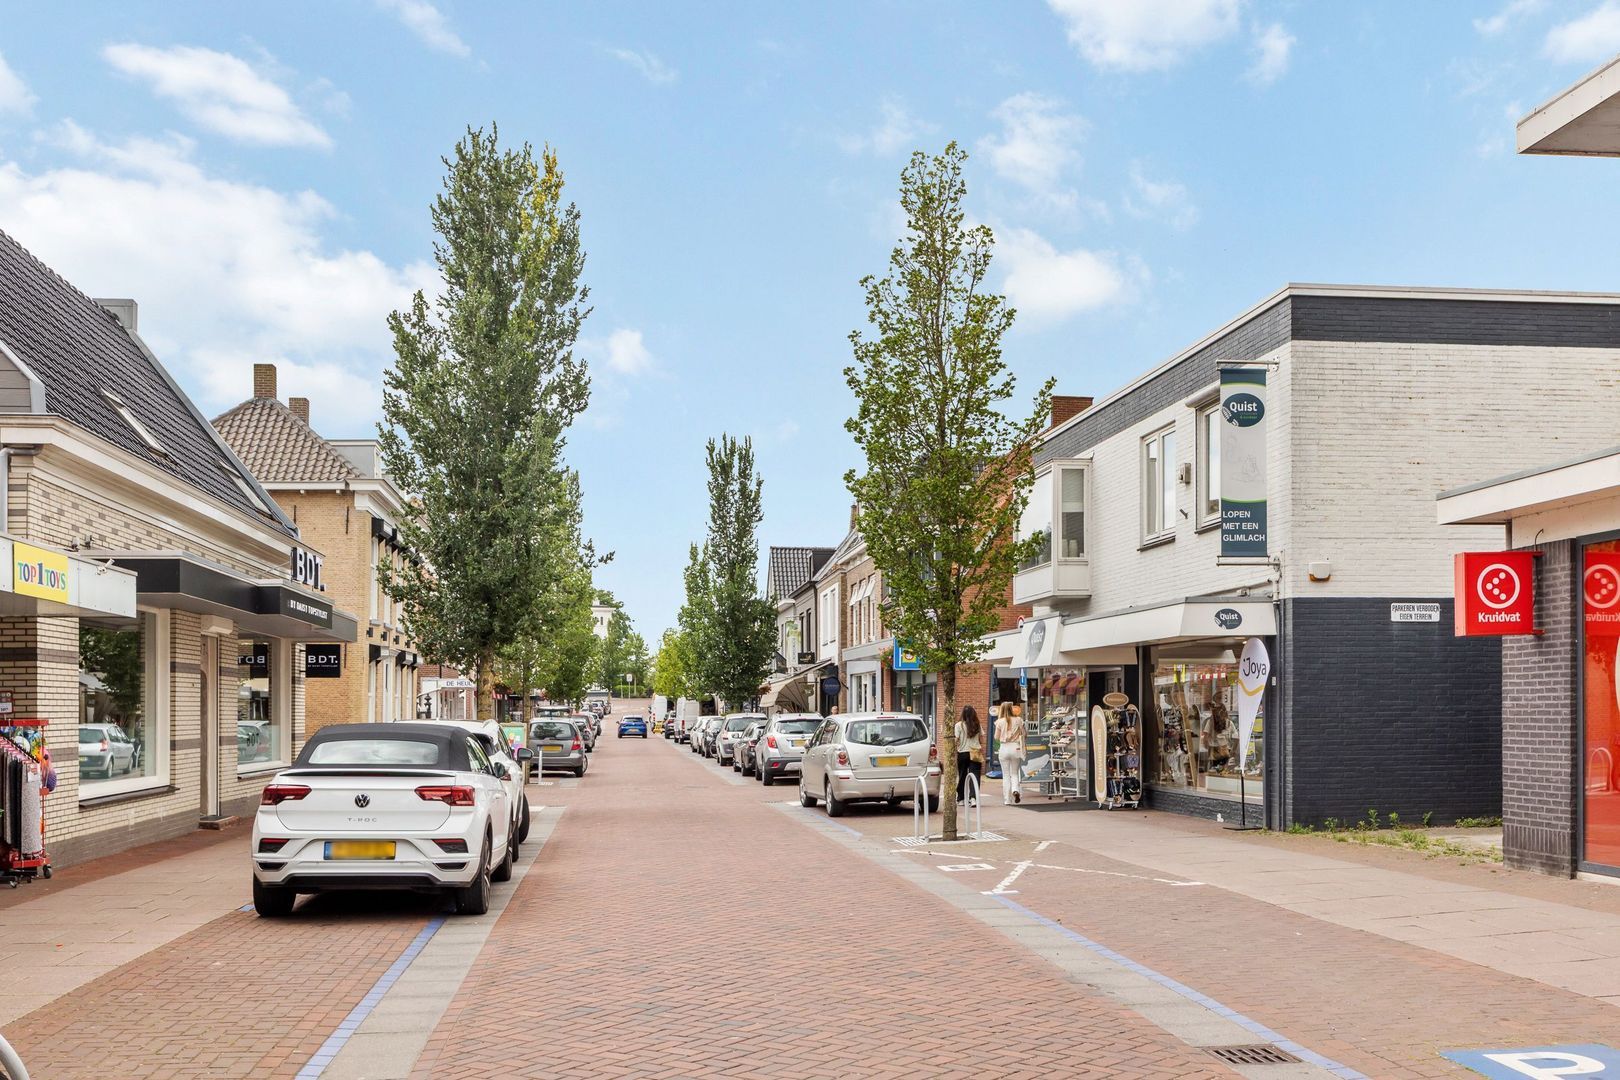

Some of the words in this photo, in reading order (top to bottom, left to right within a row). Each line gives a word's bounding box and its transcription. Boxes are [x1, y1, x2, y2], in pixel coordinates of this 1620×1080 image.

[1230, 401, 1257, 413] Quist
[18, 562, 37, 583] TOP
[37, 563, 44, 585] 1
[44, 568, 66, 591] TOYS
[1220, 611, 1239, 621] Quist
[1478, 611, 1521, 623] Kruidvat
[308, 655, 338, 664] BDT.
[1243, 657, 1267, 679] Joya
